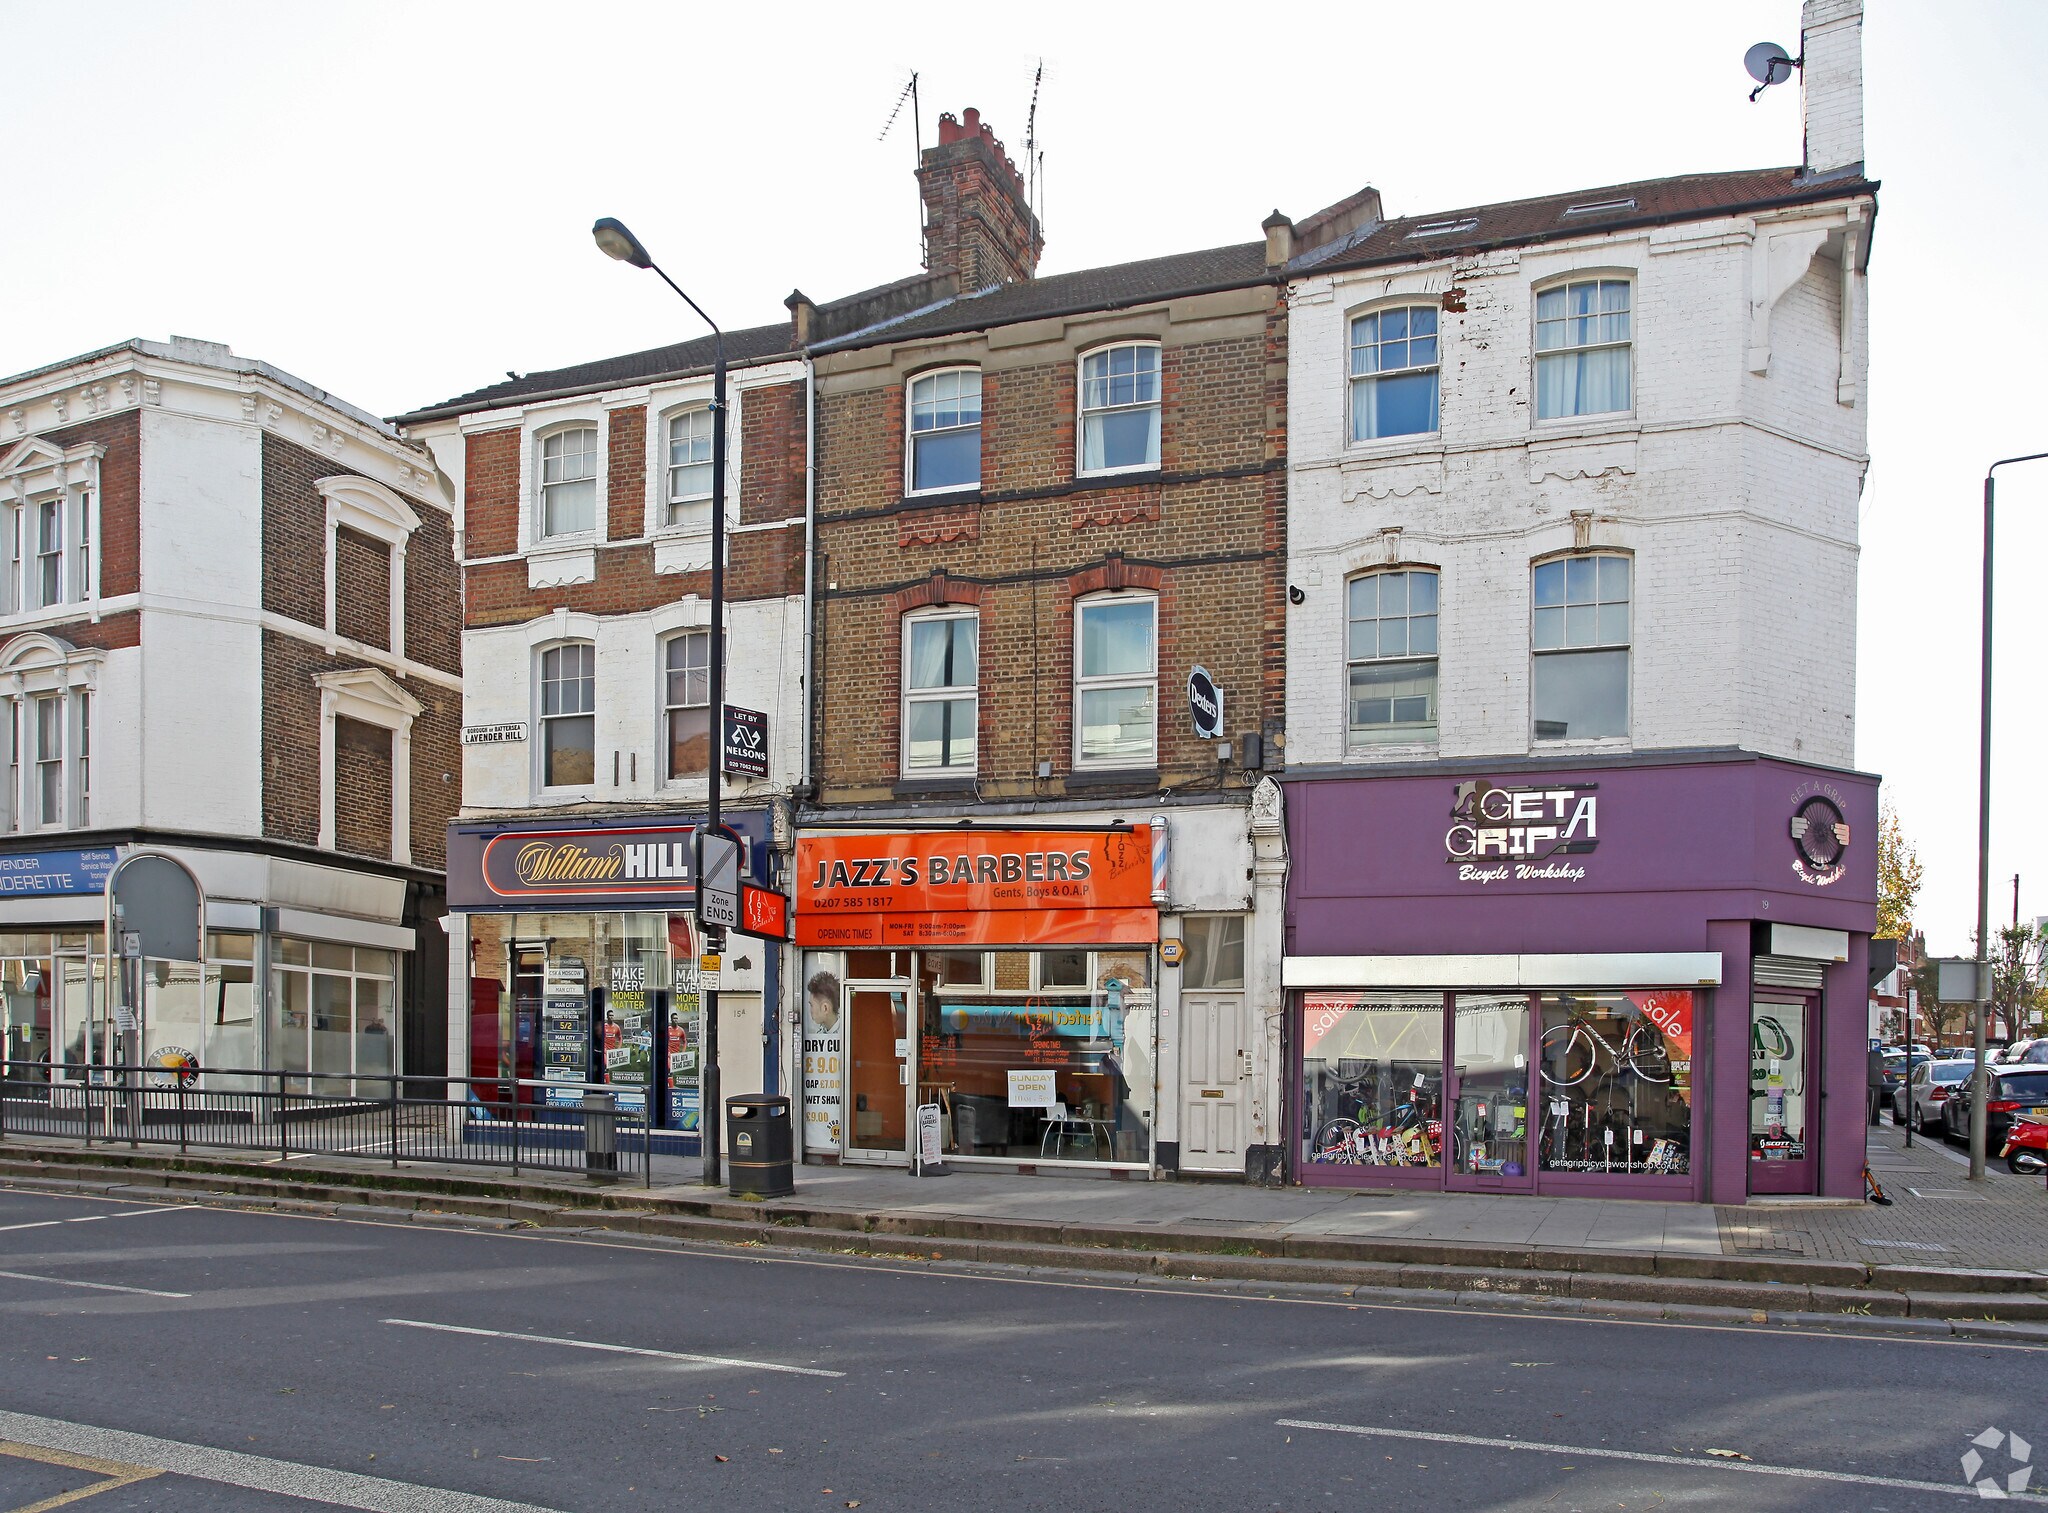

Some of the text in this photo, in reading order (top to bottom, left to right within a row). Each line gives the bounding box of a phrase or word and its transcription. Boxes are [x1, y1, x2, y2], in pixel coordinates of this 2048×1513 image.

[1191, 683, 1217, 718] Dexters
[734, 712, 747, 720] LET
[465, 731, 522, 743] LAVENDER HILL
[726, 746, 766, 761] NELSONS
[1790, 781, 1846, 808] GET A GRIP
[1481, 789, 1596, 838] GET A
[1445, 825, 1557, 856] GRIP
[802, 844, 813, 852] 17
[515, 841, 688, 881] William HILL
[812, 850, 1092, 889] JAZZ'S BARBERS
[1459, 863, 1585, 884] Bicycle Workshop
[1792, 859, 1846, 886] Bicycle Workshop
[0, 873, 74, 891] DERETTE
[90, 872, 108, 880] Ironing
[993, 885, 1089, 899] Gents, Boys & O.A.P
[711, 894, 729, 907] Zone
[814, 897, 893, 908] 0207 585 1817
[1762, 900, 1769, 910] 19
[706, 906, 734, 921] ENDS
[818, 928, 873, 940] OPENING TIMES
[1164, 946, 1177, 955] ADT
[611, 967, 645, 980] MAKE
[611, 980, 645, 991] EVERY
[611, 991, 645, 1000] MOMENT
[676, 994, 699, 1003] MOME
[611, 1000, 645, 1010] MATTER
[733, 1010, 746, 1018] 15A
[1312, 1000, 1348, 1036] sale
[1642, 998, 1683, 1038] sale
[560, 1021, 572, 1030] 5/2
[805, 1039, 840, 1053] DRY CU
[1871, 1041, 1880, 1050] P
[154, 1046, 194, 1060] SERVICE
[560, 1054, 572, 1062] 3/1
[805, 1056, 840, 1074] £ 9.0
[153, 1076, 195, 1090] WASES
[805, 1079, 819, 1089] OAP
[805, 1095, 840, 1105] WET SHAV
[806, 1112, 829, 1122] £9.00
[1549, 1158, 1680, 1170] getagripbicycleworkshop.co.uk
